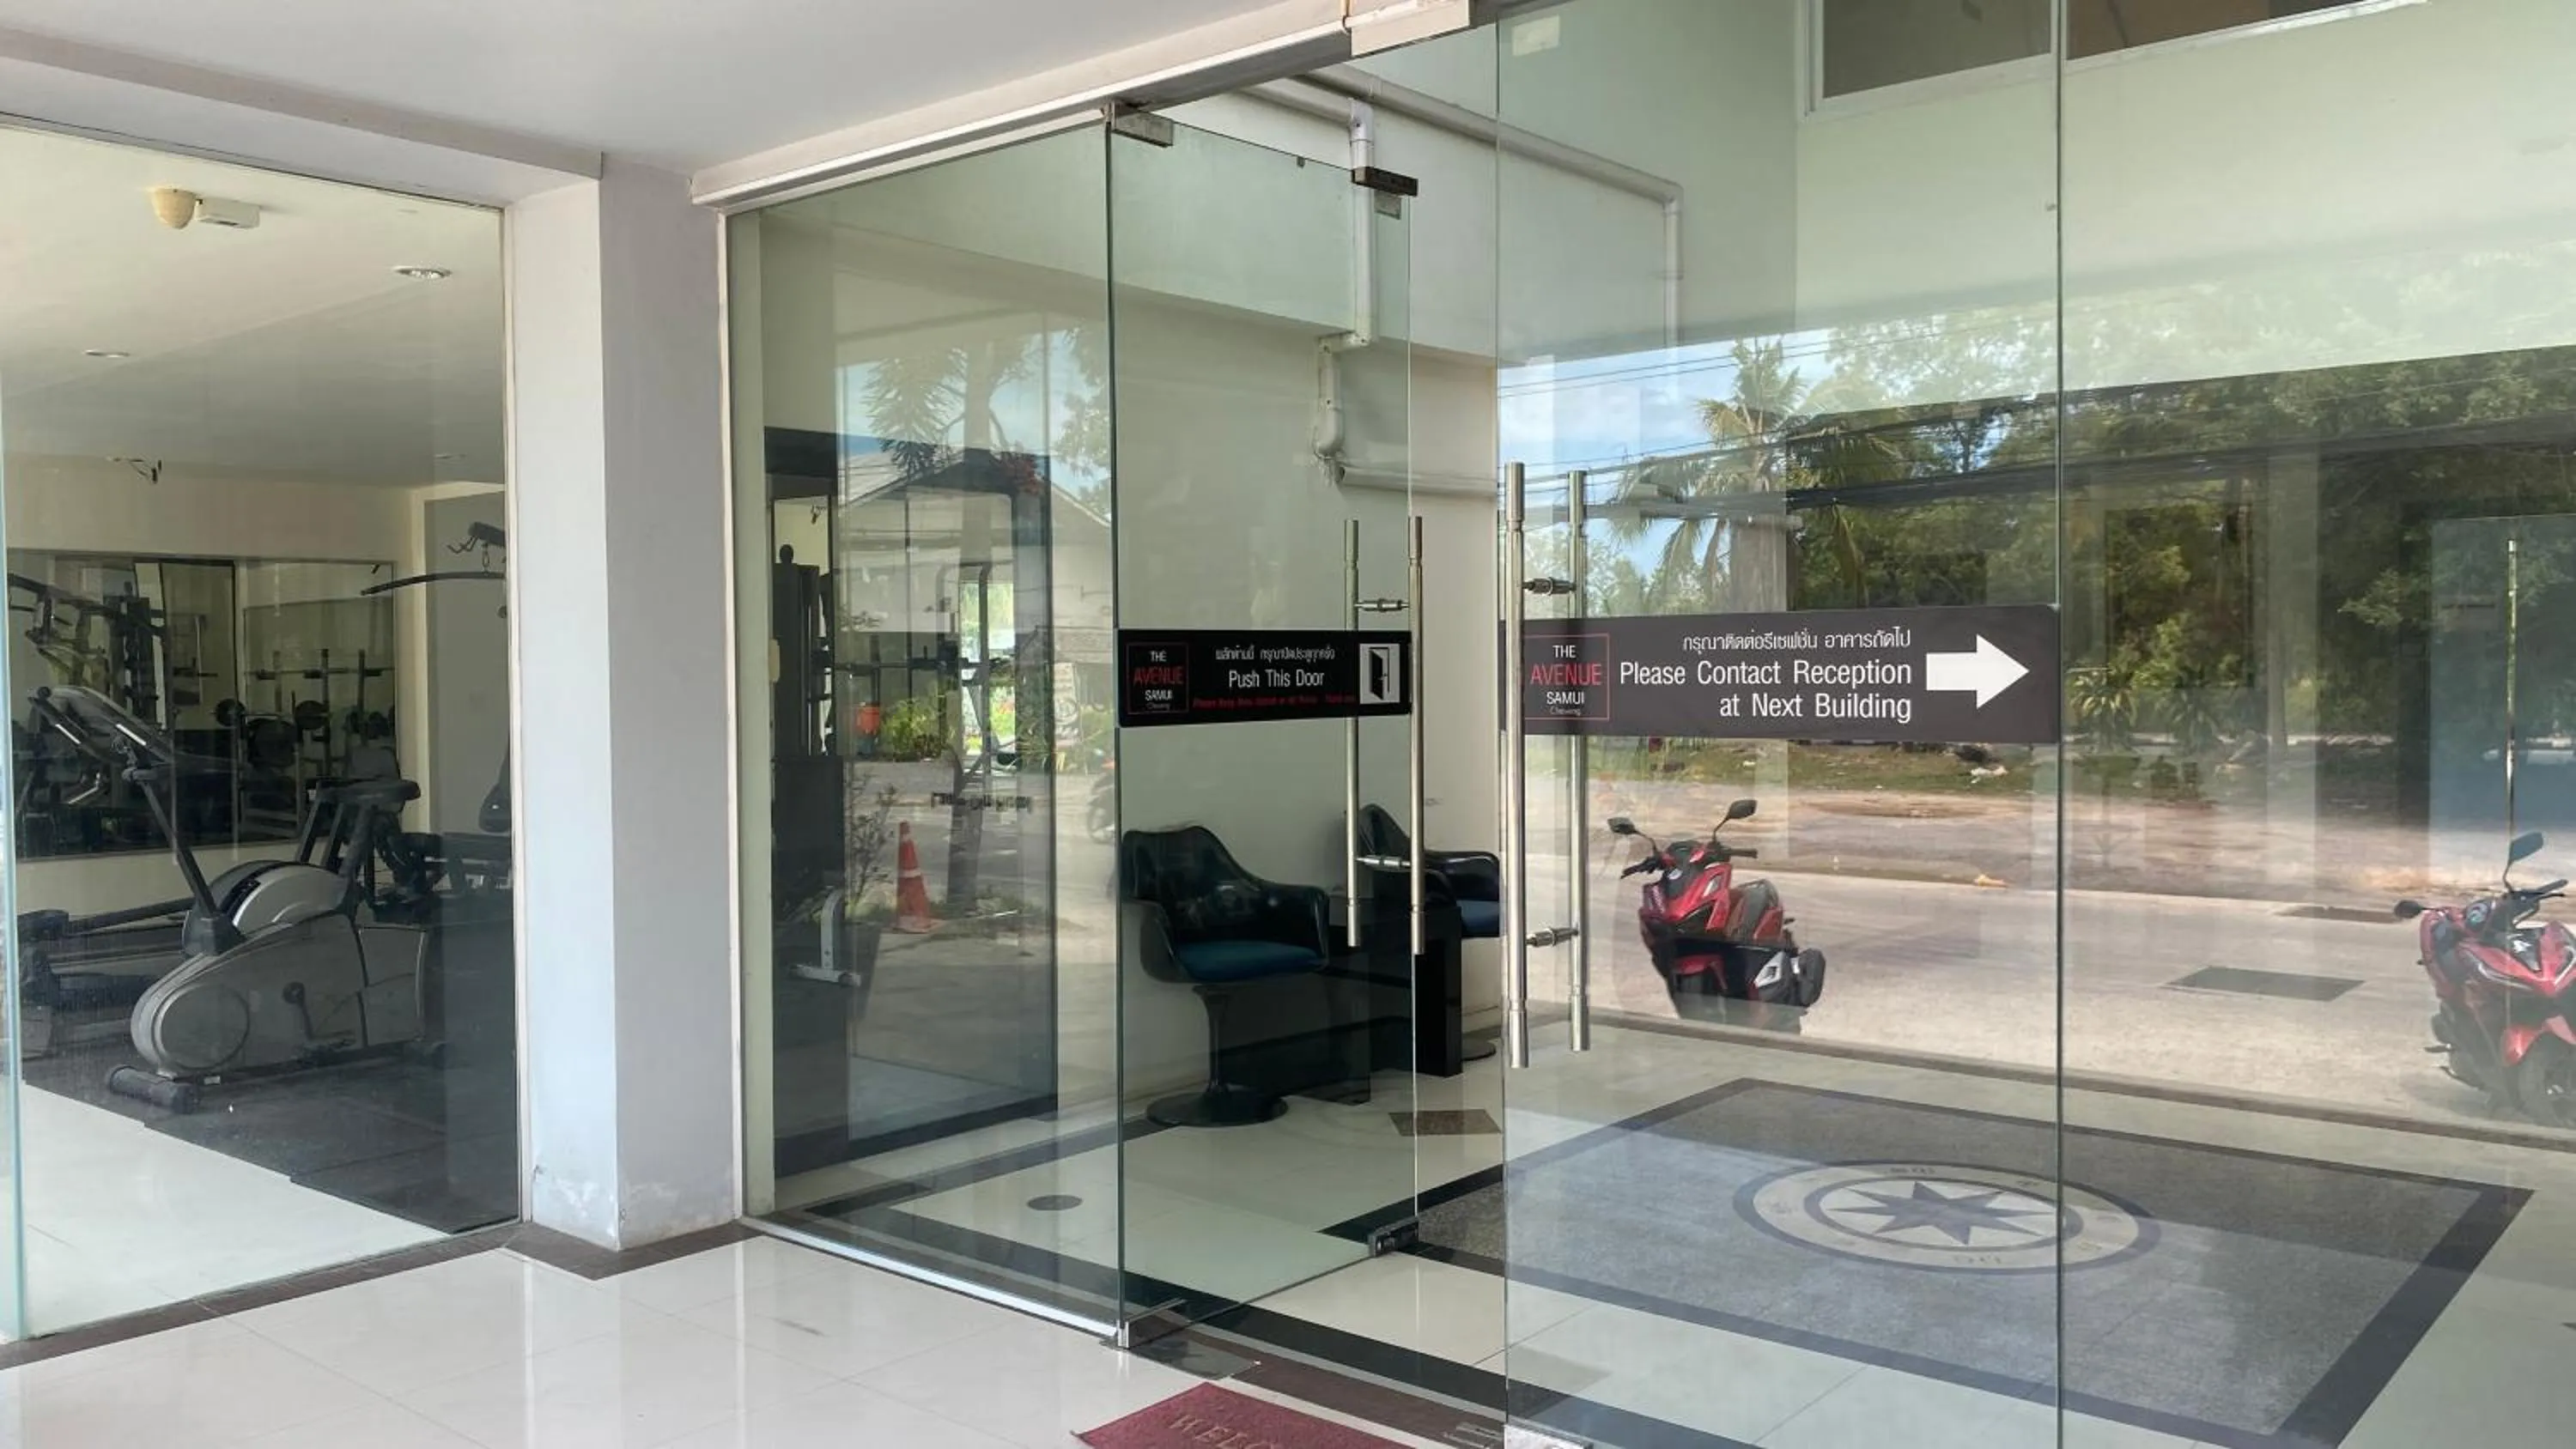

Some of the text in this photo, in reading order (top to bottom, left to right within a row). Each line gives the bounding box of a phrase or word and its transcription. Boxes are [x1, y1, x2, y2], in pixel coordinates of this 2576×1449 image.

[1150, 650, 1168, 662] THE
[1552, 645, 1577, 658] THE
[1133, 665, 1184, 687] AVENUE
[1229, 668, 1325, 688] Push This Door
[1530, 663, 1602, 686] AVENUE
[1619, 659, 1912, 689] Please Contact Reception
[1145, 689, 1173, 701] SAMUI
[1546, 690, 1585, 705] SAMUI
[1720, 693, 1912, 724] at Next Building
